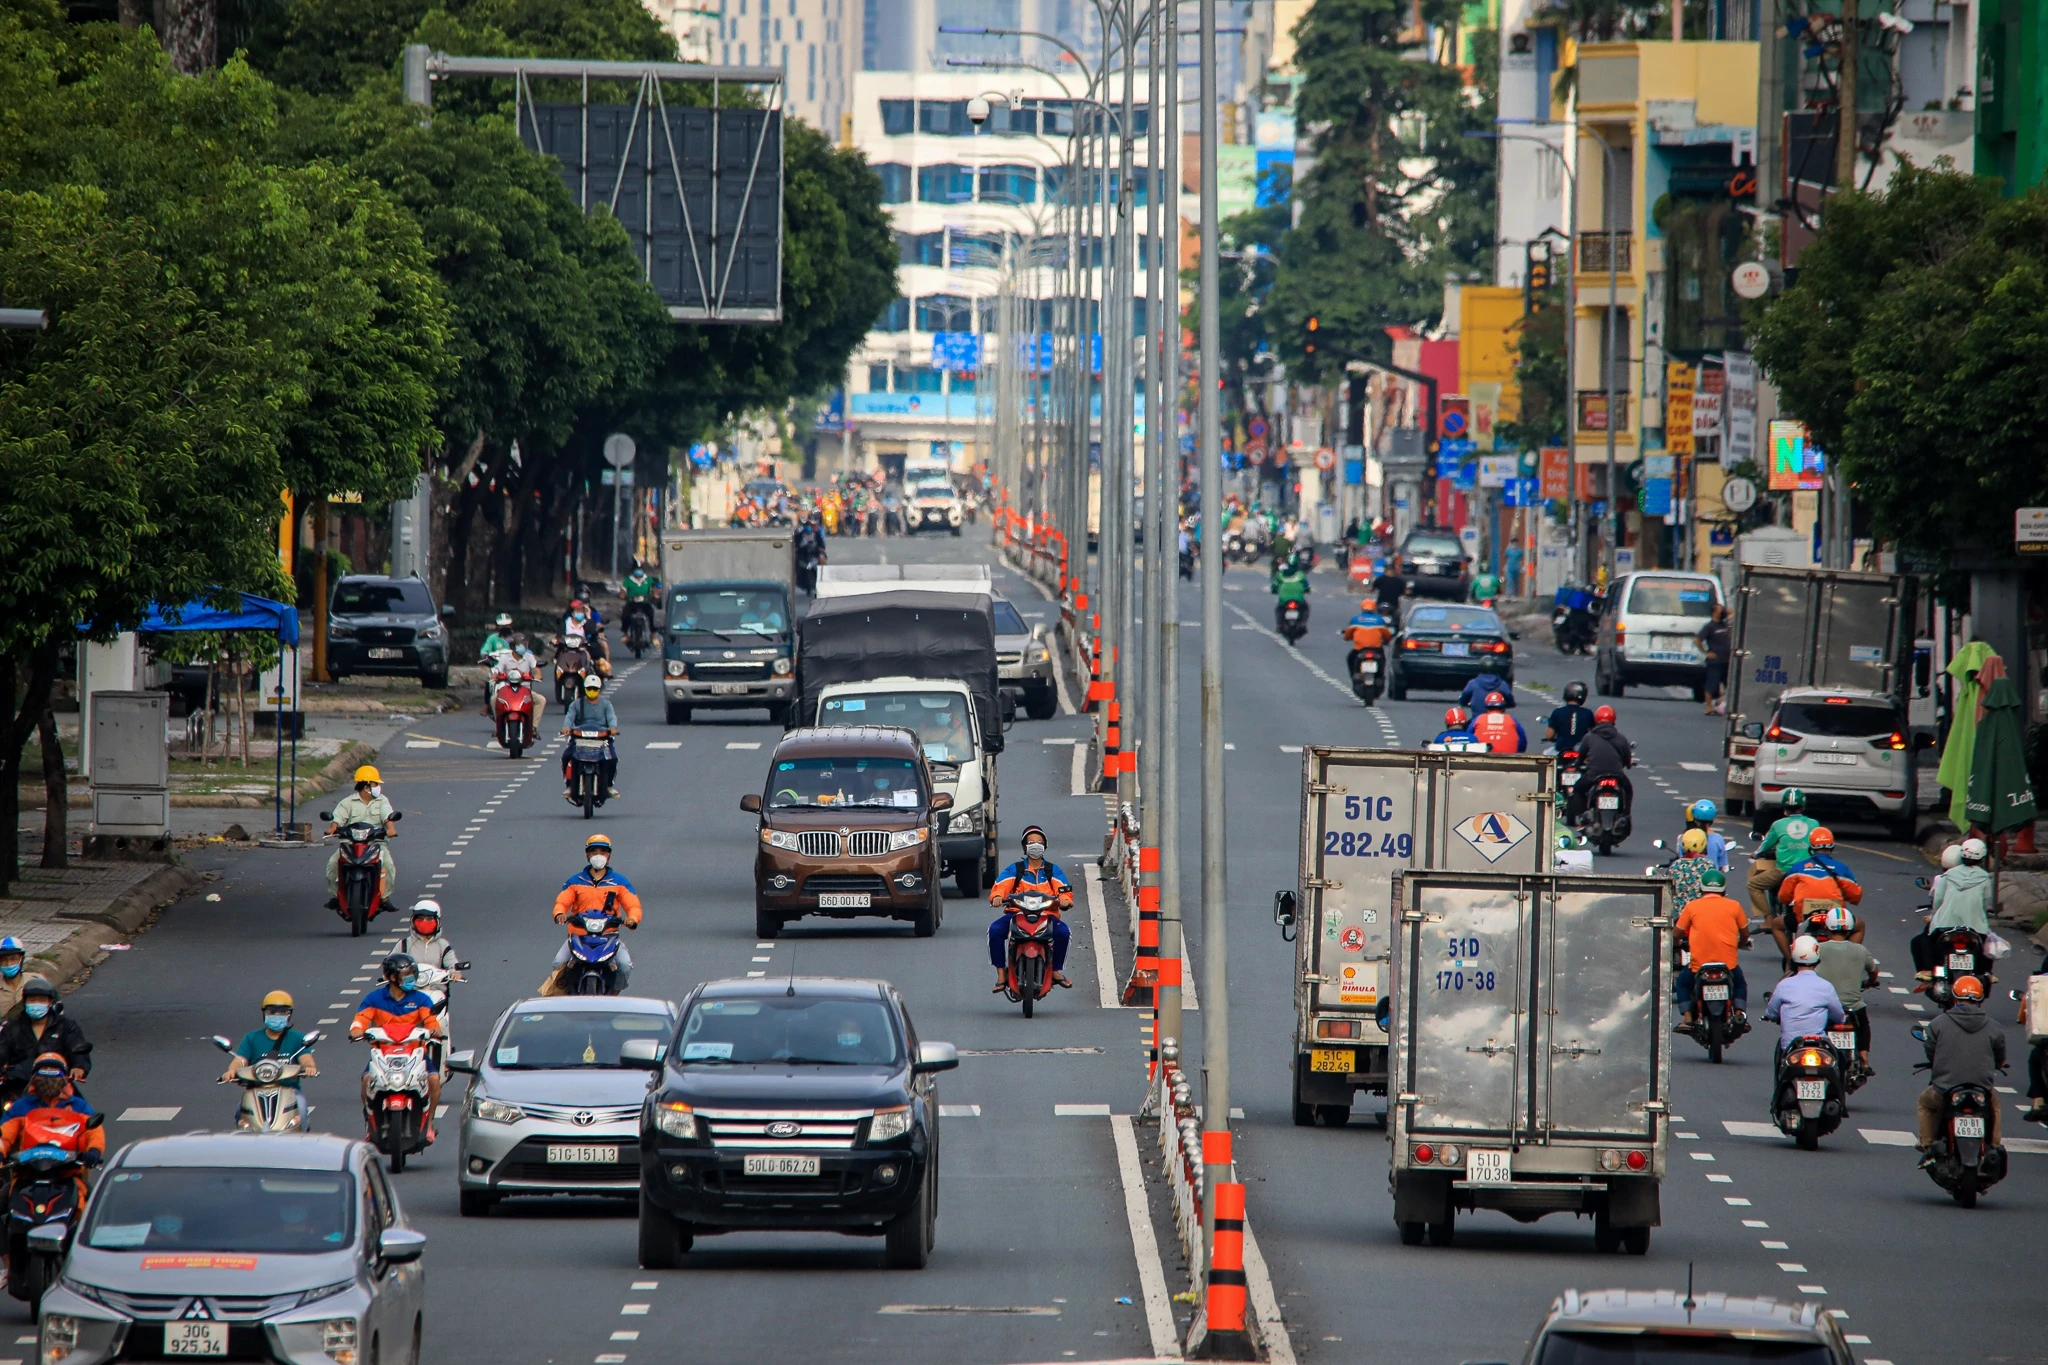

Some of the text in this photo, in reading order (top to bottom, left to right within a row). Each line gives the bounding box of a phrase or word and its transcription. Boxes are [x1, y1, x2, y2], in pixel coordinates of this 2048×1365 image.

[1345, 796, 1393, 821] 51C
[1324, 832, 1412, 858] 282.49
[1448, 938, 1480, 957] 51D
[1436, 971, 1495, 990] 170-38
[1324, 1051, 1342, 1060] 51C
[1316, 1062, 1350, 1071] 282.49
[1801, 1090, 1820, 1098] 1752
[772, 1124, 793, 1133] Ford
[549, 1148, 616, 1161] 51G-151.13
[1477, 1154, 1500, 1167] 51D
[749, 1159, 815, 1173] 50LD-062.29
[1470, 1167, 1509, 1181] 170.38
[183, 1325, 210, 1338] 30G
[171, 1339, 220, 1354] 925.34
